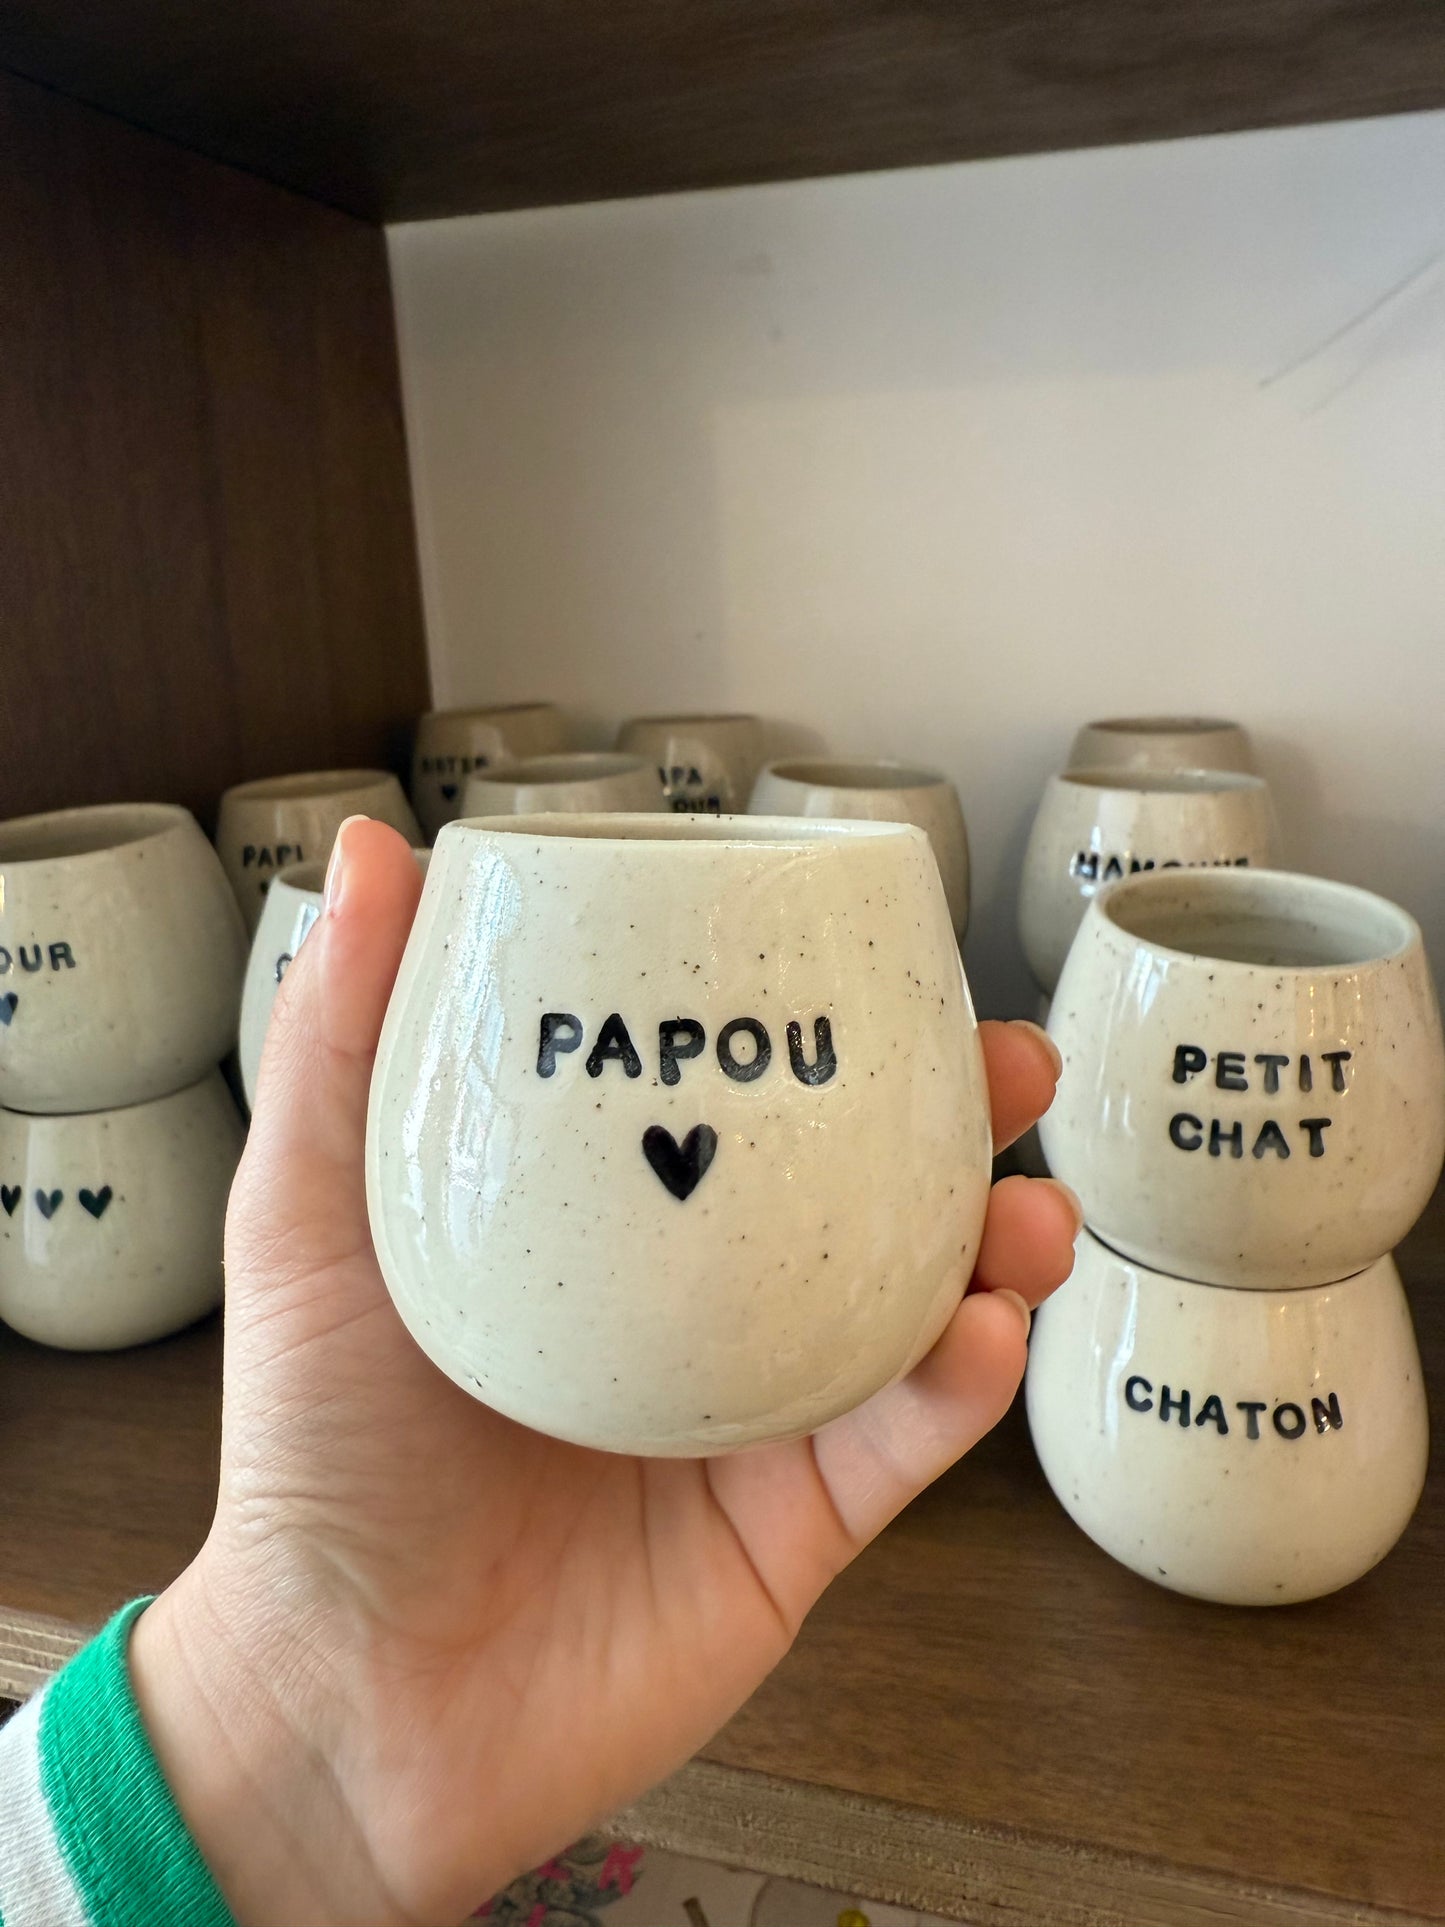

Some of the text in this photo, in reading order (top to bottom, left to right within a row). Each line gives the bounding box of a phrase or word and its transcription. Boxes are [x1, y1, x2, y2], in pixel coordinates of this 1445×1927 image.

[243, 844, 304, 868] PAPI
[536, 1012, 838, 1086] PAPOU
[1172, 1044, 1352, 1093] PETIT
[1168, 1112, 1332, 1159] CHAT
[1125, 1375, 1344, 1440] CHATON
